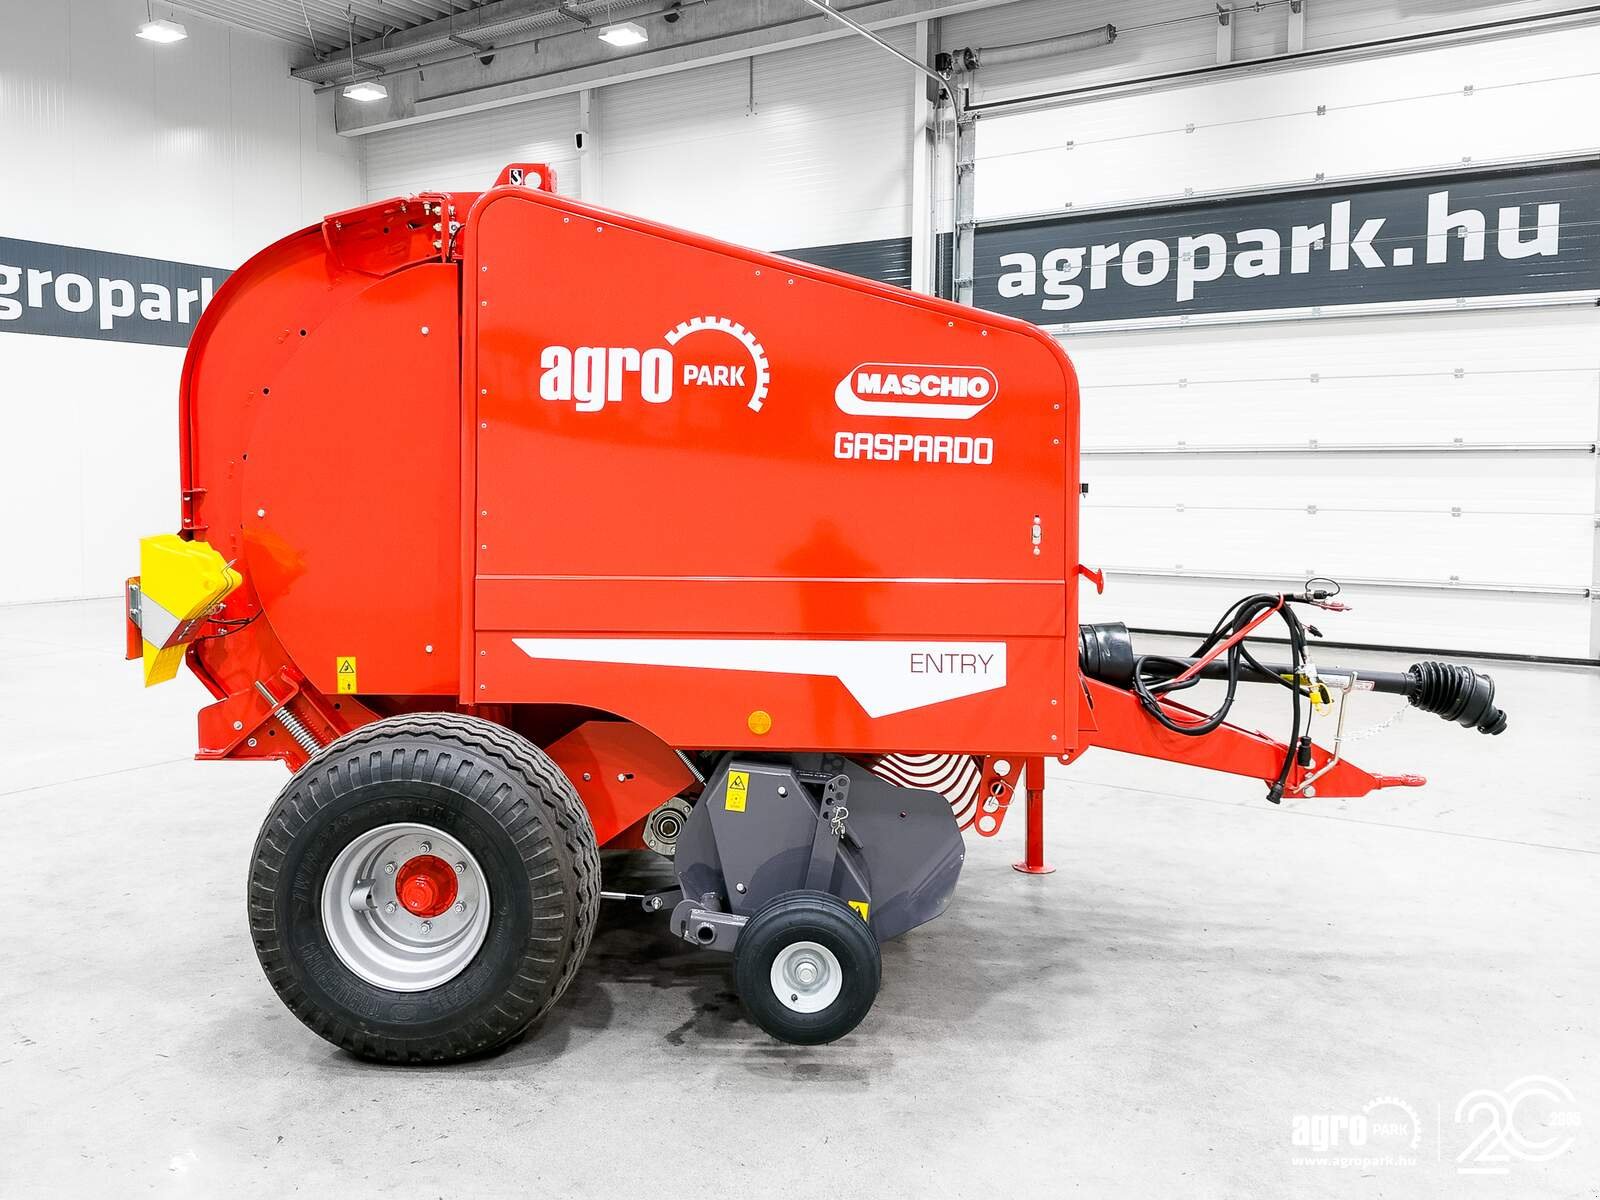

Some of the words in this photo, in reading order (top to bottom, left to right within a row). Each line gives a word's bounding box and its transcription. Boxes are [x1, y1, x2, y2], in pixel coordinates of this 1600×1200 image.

[997, 190, 1560, 311] agropark.hu
[540, 345, 674, 412] agro
[683, 364, 745, 387] PARK
[857, 373, 990, 399] MASCHIO
[834, 431, 994, 465] GASPARDO
[910, 653, 994, 674] ENTRY
